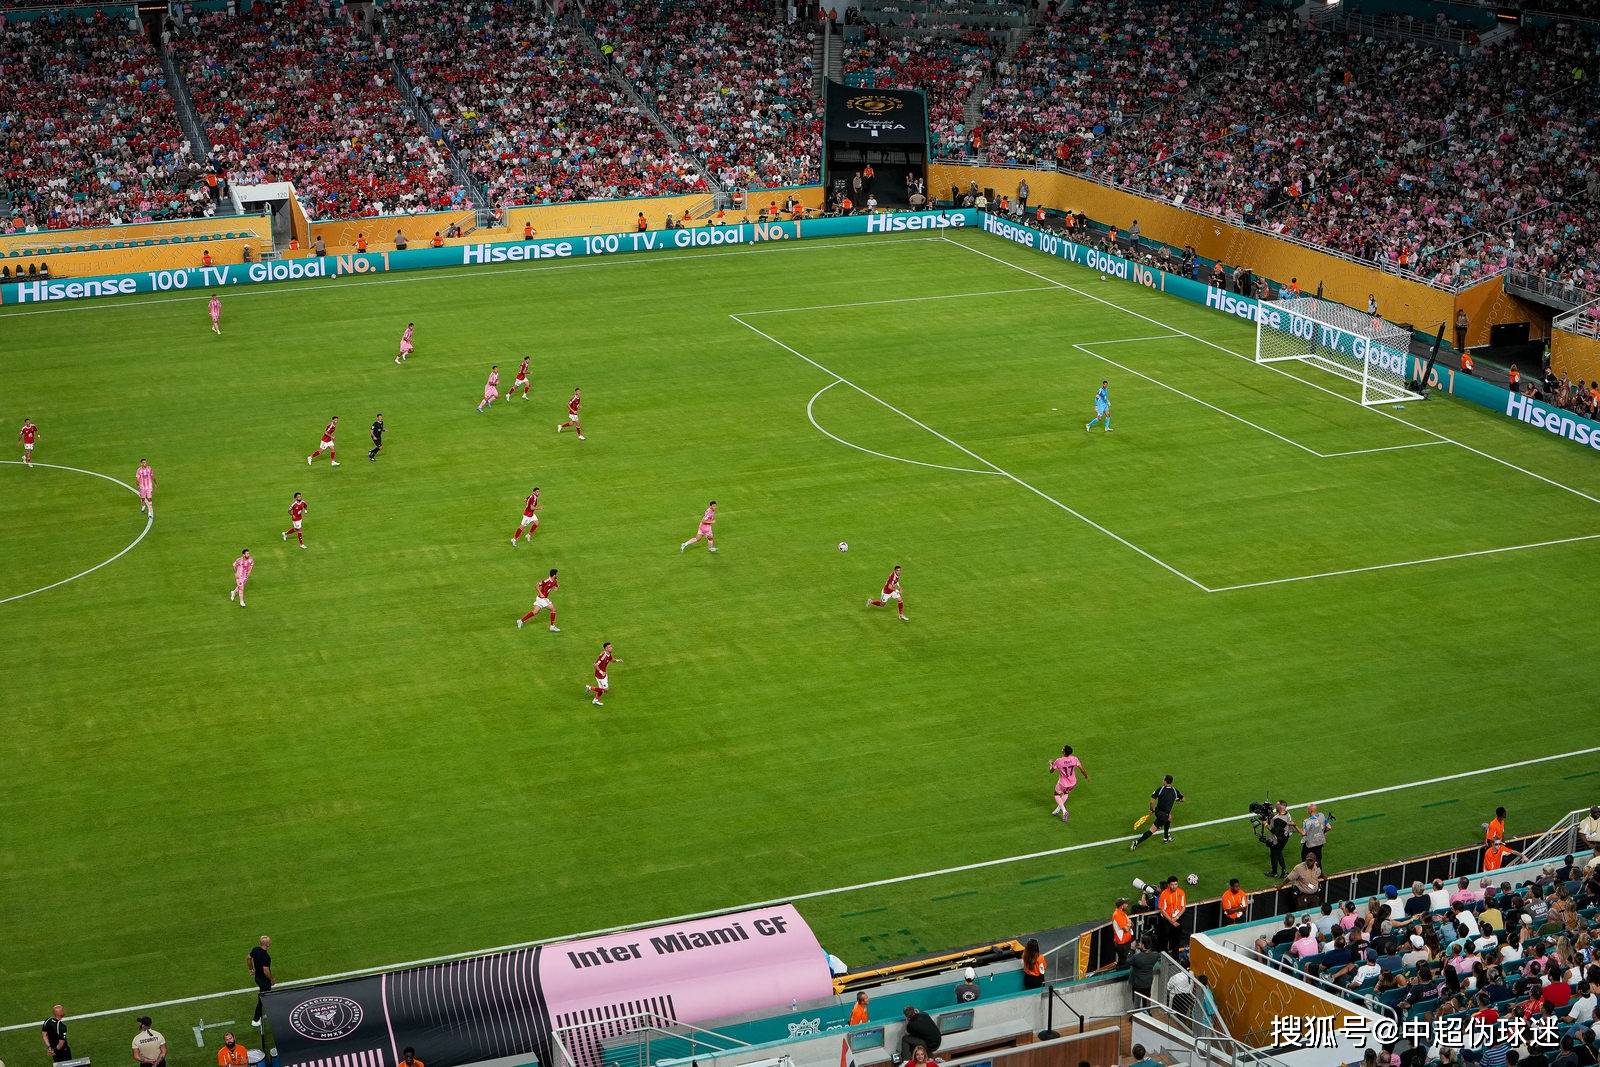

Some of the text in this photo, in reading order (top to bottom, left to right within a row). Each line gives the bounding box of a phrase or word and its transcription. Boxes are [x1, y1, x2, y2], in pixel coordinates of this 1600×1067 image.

[463, 242, 572, 264] Hisense
[674, 225, 744, 248] Global
[752, 222, 788, 242] No.
[794, 220, 801, 239] 1
[867, 210, 966, 232] Hisense
[18, 278, 136, 303] Hisense
[248, 258, 325, 282] Global
[336, 254, 376, 275] No.
[380, 252, 390, 271] 1
[984, 212, 1034, 248] Hisense
[1086, 249, 1128, 280] Global
[1133, 262, 1156, 289] No.
[1160, 270, 1166, 292] 1
[1206, 286, 1281, 328] Hisense
[1290, 313, 1314, 340] 100
[1352, 338, 1407, 376] Gobal
[1412, 357, 1443, 390] No.
[1448, 369, 1455, 395] 1
[1506, 391, 1600, 453] Hisense
[1062, 765, 1075, 777] 17
[567, 916, 788, 970] Inter Miami CF
[1422, 988, 1438, 997] MESS
